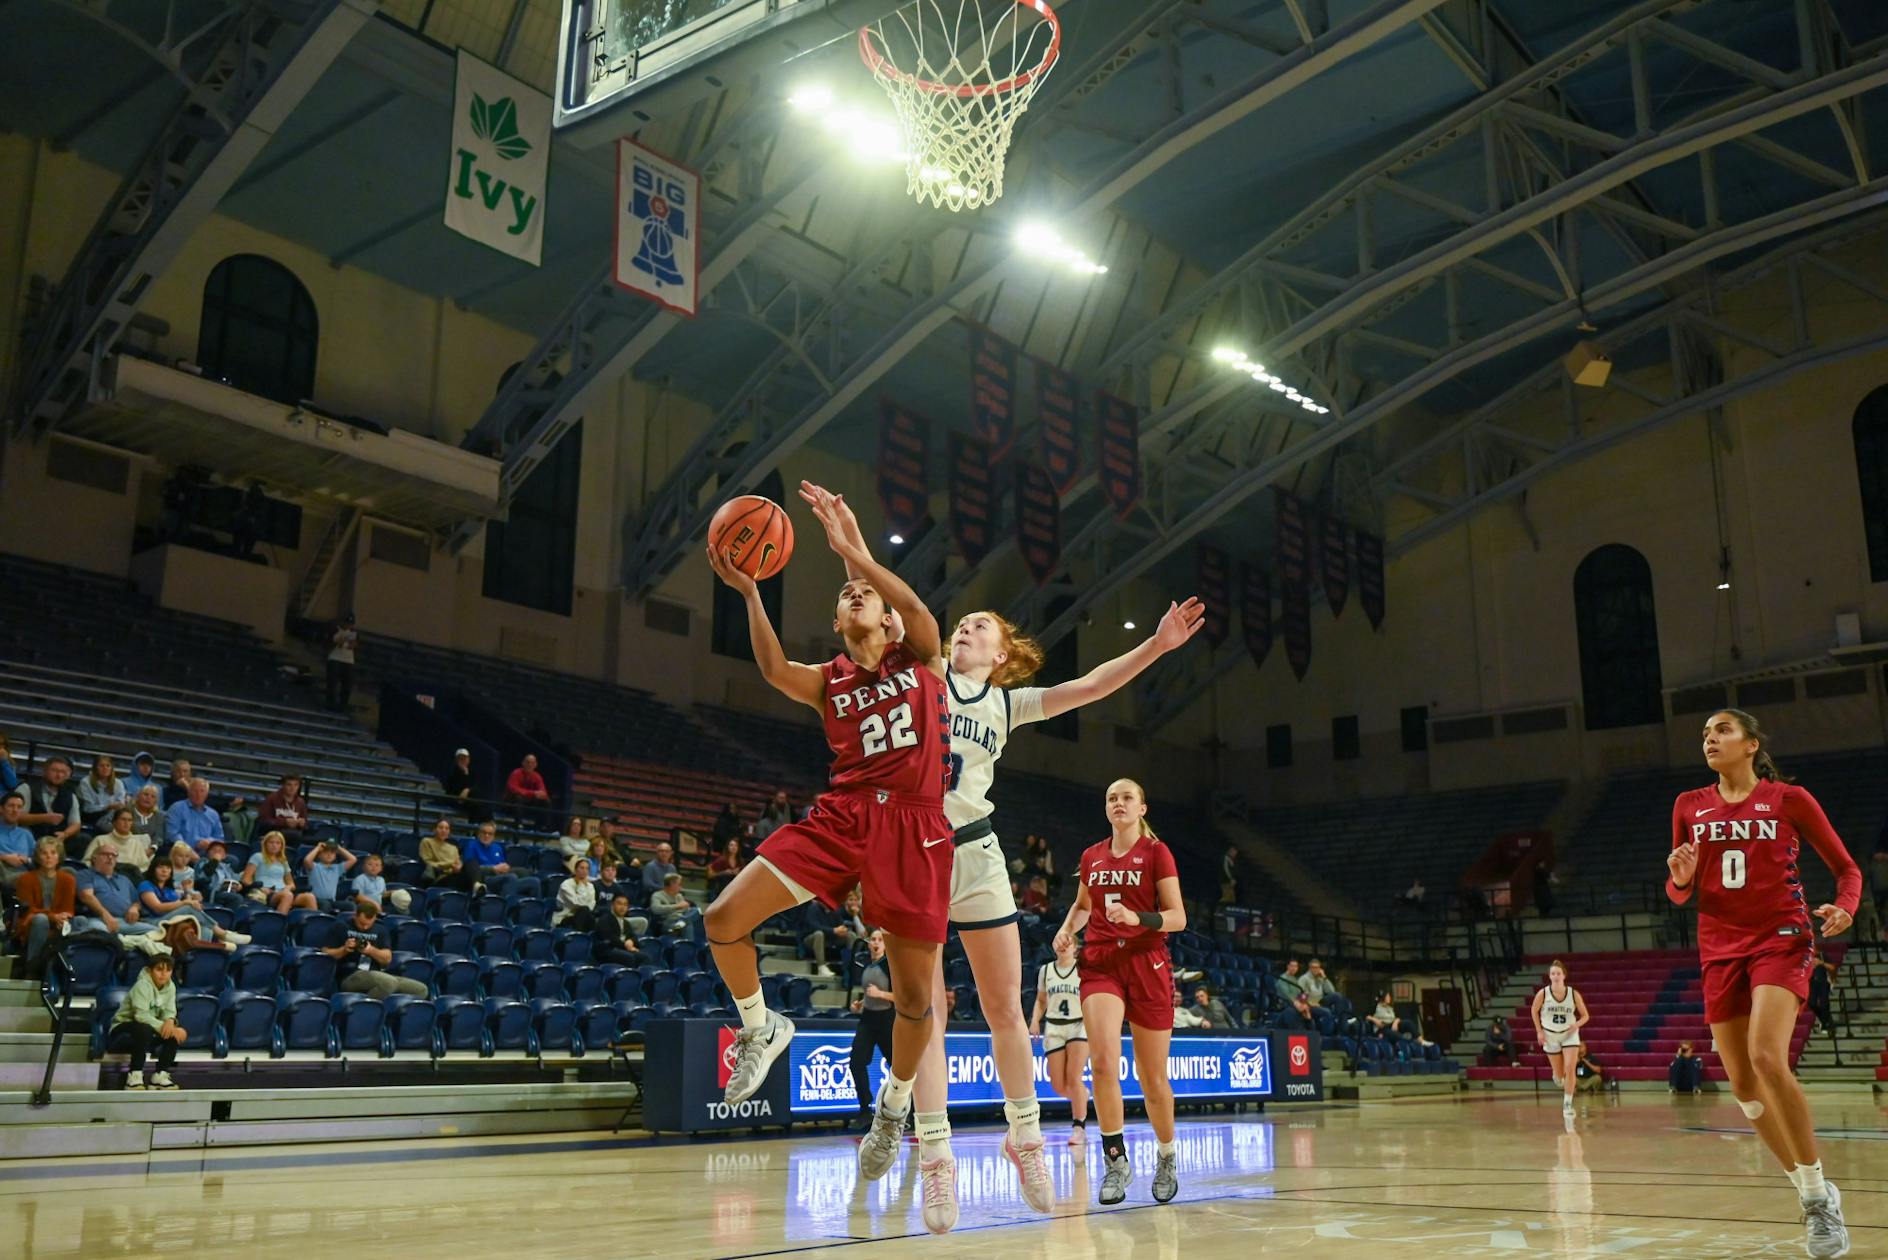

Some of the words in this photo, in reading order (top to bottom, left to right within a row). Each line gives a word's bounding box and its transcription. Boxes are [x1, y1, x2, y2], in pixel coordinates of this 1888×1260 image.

[454, 147, 537, 236] Ivy
[633, 165, 686, 206] BIG
[831, 667, 919, 719] PENN
[859, 702, 919, 758] 22
[949, 713, 998, 757] CULAT
[1692, 819, 1778, 843] PENN
[1088, 870, 1143, 887] PENN
[1721, 849, 1746, 889] 0
[1059, 999, 1070, 1016] 4
[1552, 1014, 1567, 1024] 25
[798, 1063, 857, 1089] NECA
[1286, 1084, 1316, 1096] TOYOTA
[707, 1100, 773, 1120] TOYOTA
